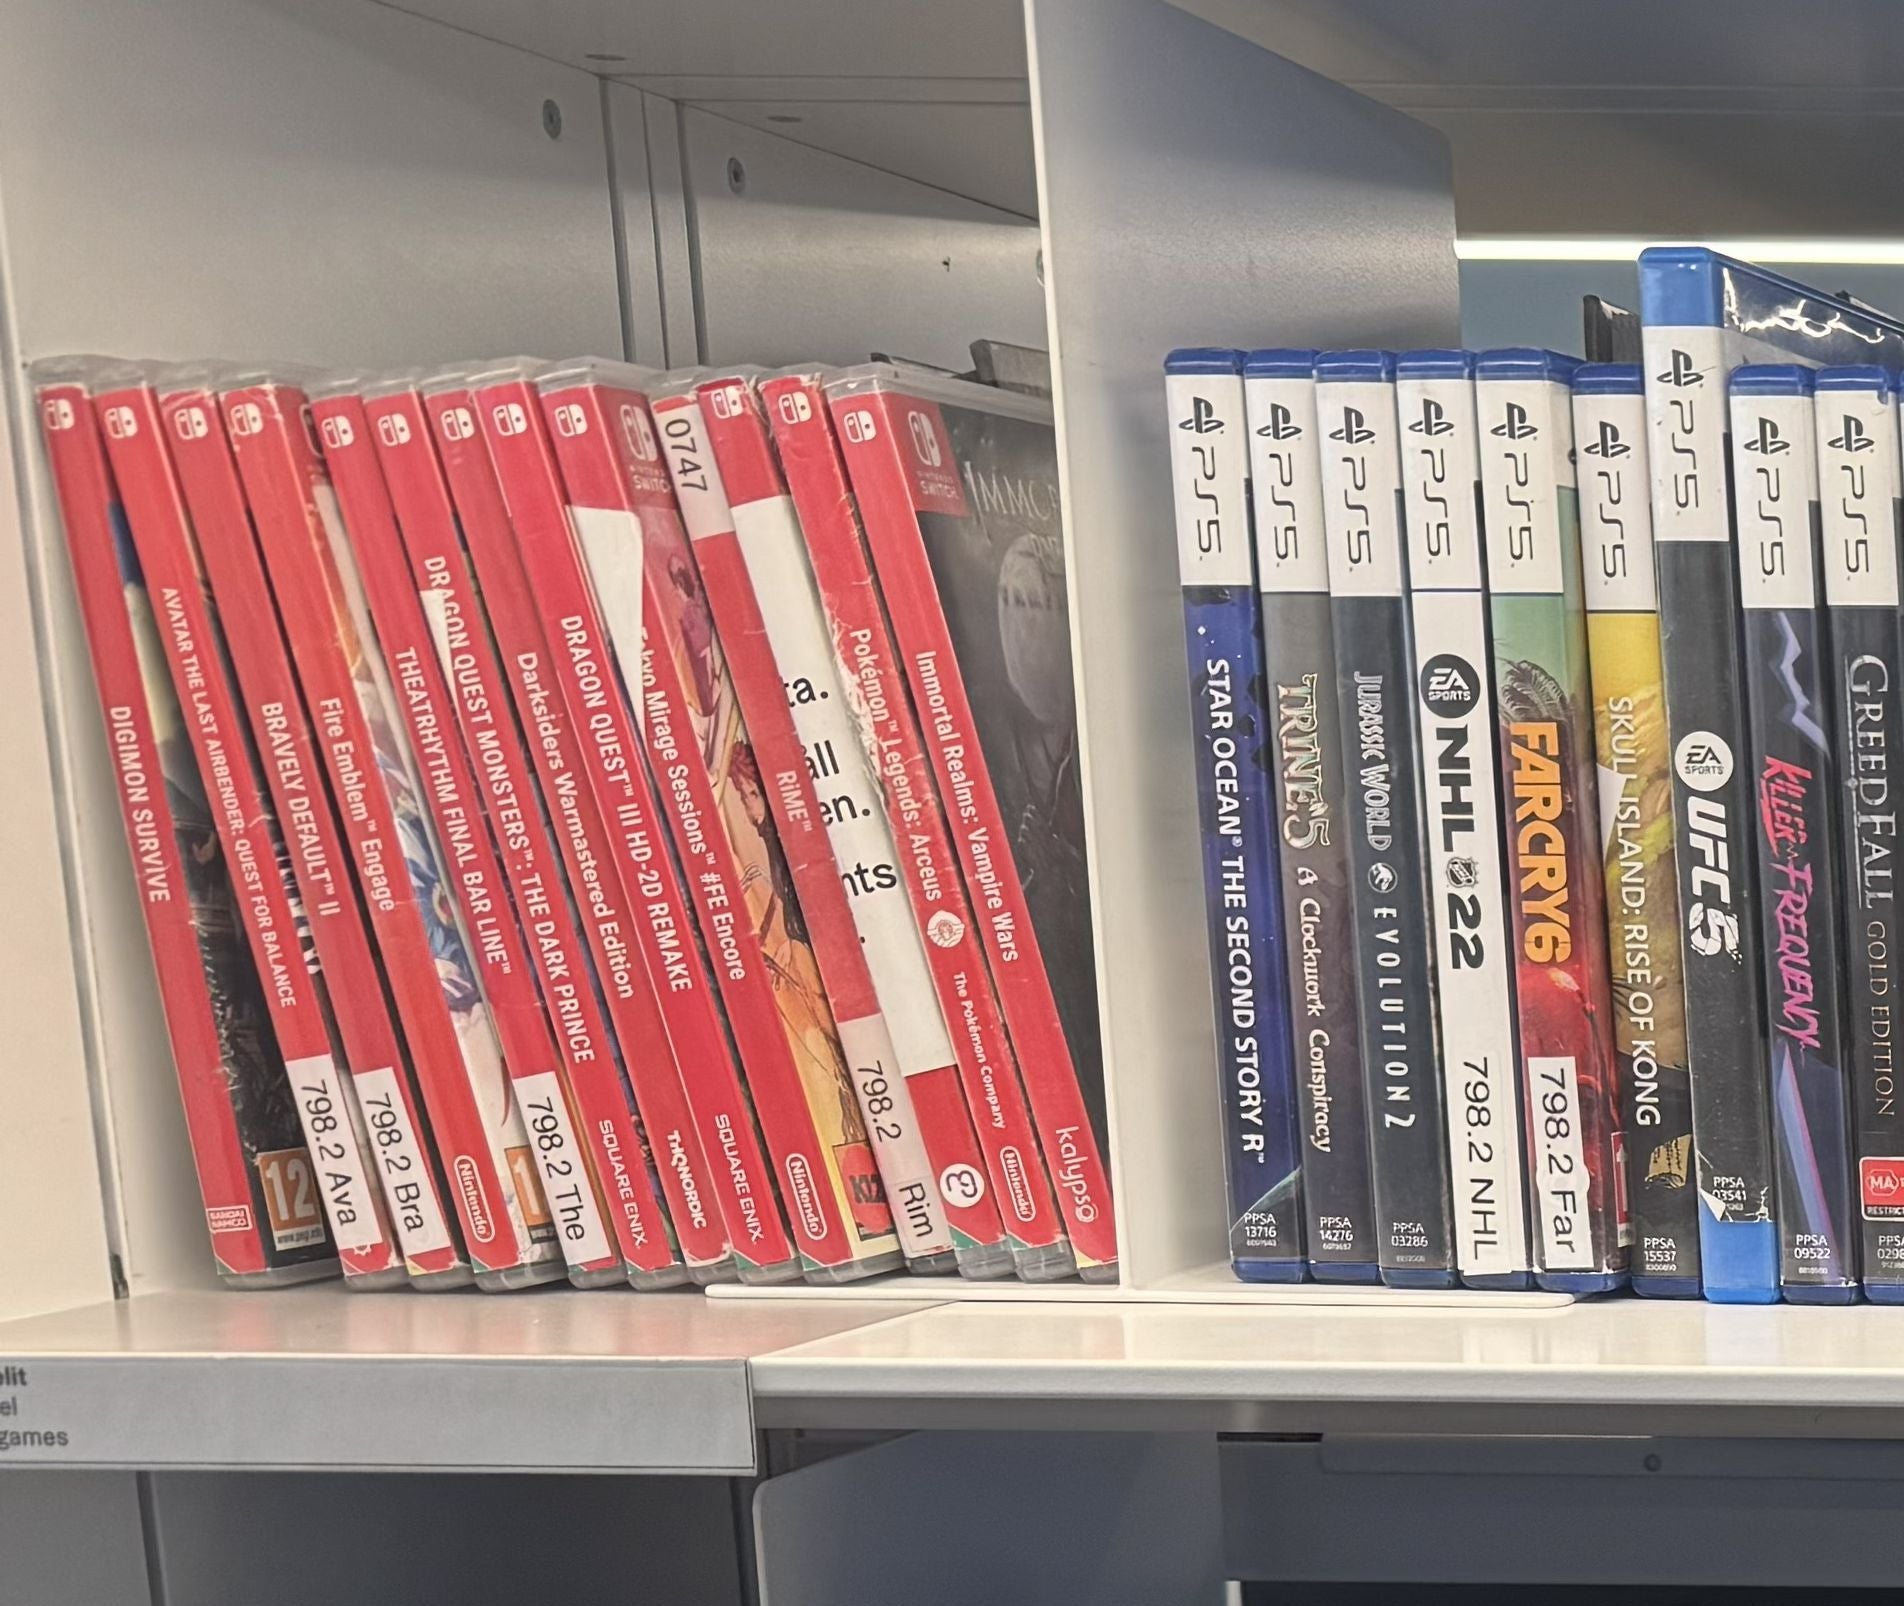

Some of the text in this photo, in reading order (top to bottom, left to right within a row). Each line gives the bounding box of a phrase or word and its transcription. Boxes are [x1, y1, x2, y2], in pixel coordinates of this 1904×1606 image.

[664, 417, 708, 493] 0747
[1207, 659, 1235, 730] STAR
[110, 706, 170, 902] DIGIMON SURVIVE
[161, 586, 297, 1009] AVATAR THE LAST AIRBENDER: QUEST FOR BALANCE
[518, 652, 635, 999] Darksiders Warmastered Edition
[915, 649, 1019, 962] Immortal Realms: Vampire Wars
[1436, 726, 1485, 970] NHL 22
[1688, 802, 1731, 904] UFC
[1220, 855, 1245, 910] THE
[1225, 917, 1254, 1028] SECOND
[1297, 897, 1320, 1018] Clockwork
[1615, 797, 1661, 1127] ISLAND: RISE OF KONG
[1866, 922, 1894, 1117] GOLD EDITION
[953, 972, 1006, 1130] The Pokémon Company
[1235, 1037, 1263, 1127] STORY
[1307, 1028, 1331, 1153] Conspiracy
[301, 1079, 358, 1227] 798.2 Ava
[365, 1092, 424, 1234] 798.2 Bra
[457, 1161, 492, 1239] Nintendo
[527, 1096, 585, 1241] 798.2 The
[599, 1120, 648, 1249] SQUARE ENIX
[857, 1060, 933, 1239] 798.2 Rim
[1056, 1126, 1099, 1225] kalypso
[1463, 1055, 1499, 1262] 798.2 NHL
[1540, 1068, 1576, 1254] 798.2 Far
